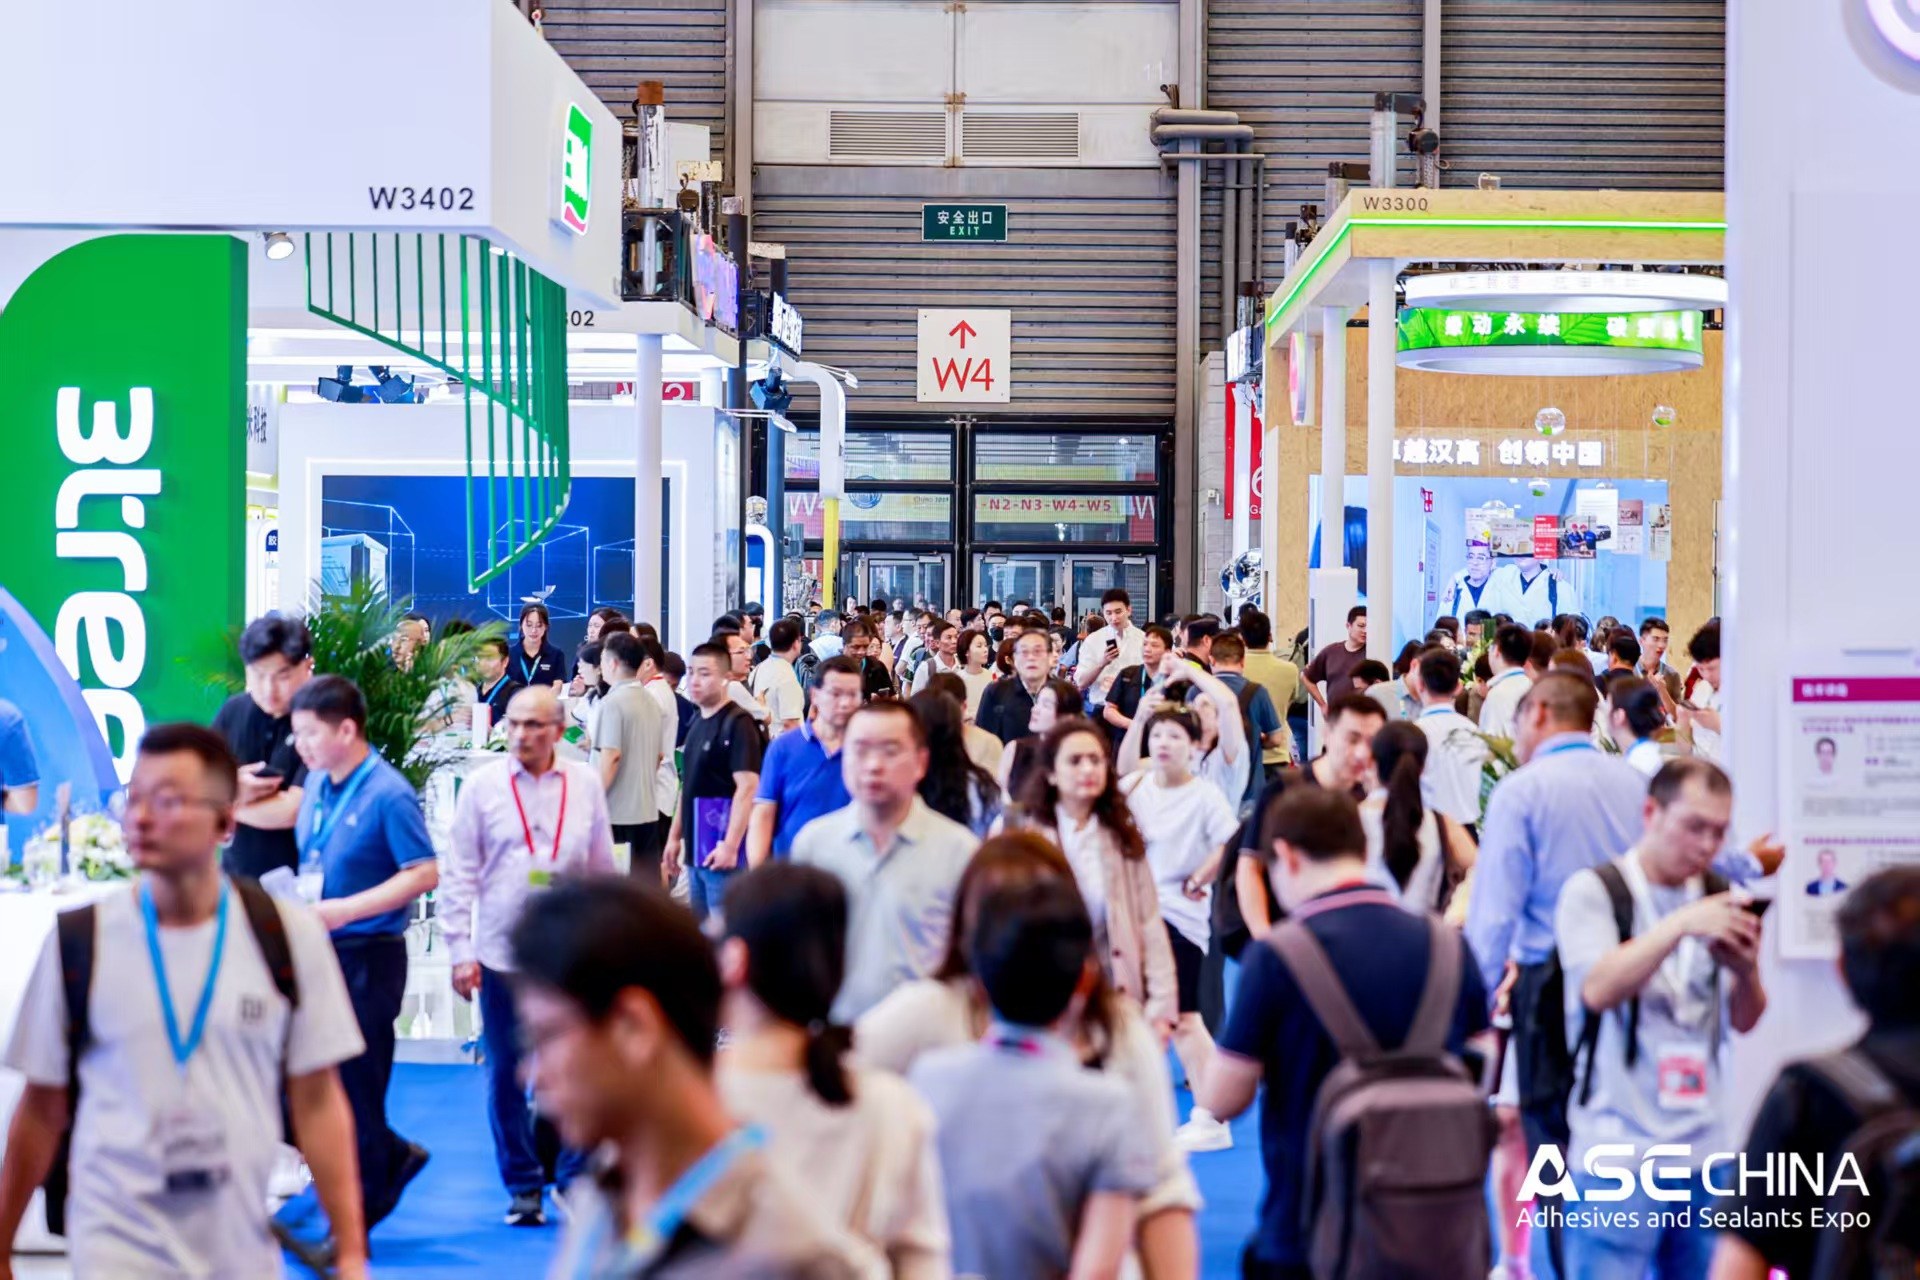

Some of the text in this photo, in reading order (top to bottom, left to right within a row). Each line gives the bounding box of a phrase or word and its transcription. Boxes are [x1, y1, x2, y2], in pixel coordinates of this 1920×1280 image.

[368, 186, 475, 210] W3402
[1363, 196, 1428, 211] W3300
[937, 210, 993, 225] 安全出口
[949, 226, 980, 236] EXIT
[932, 356, 995, 392] W4
